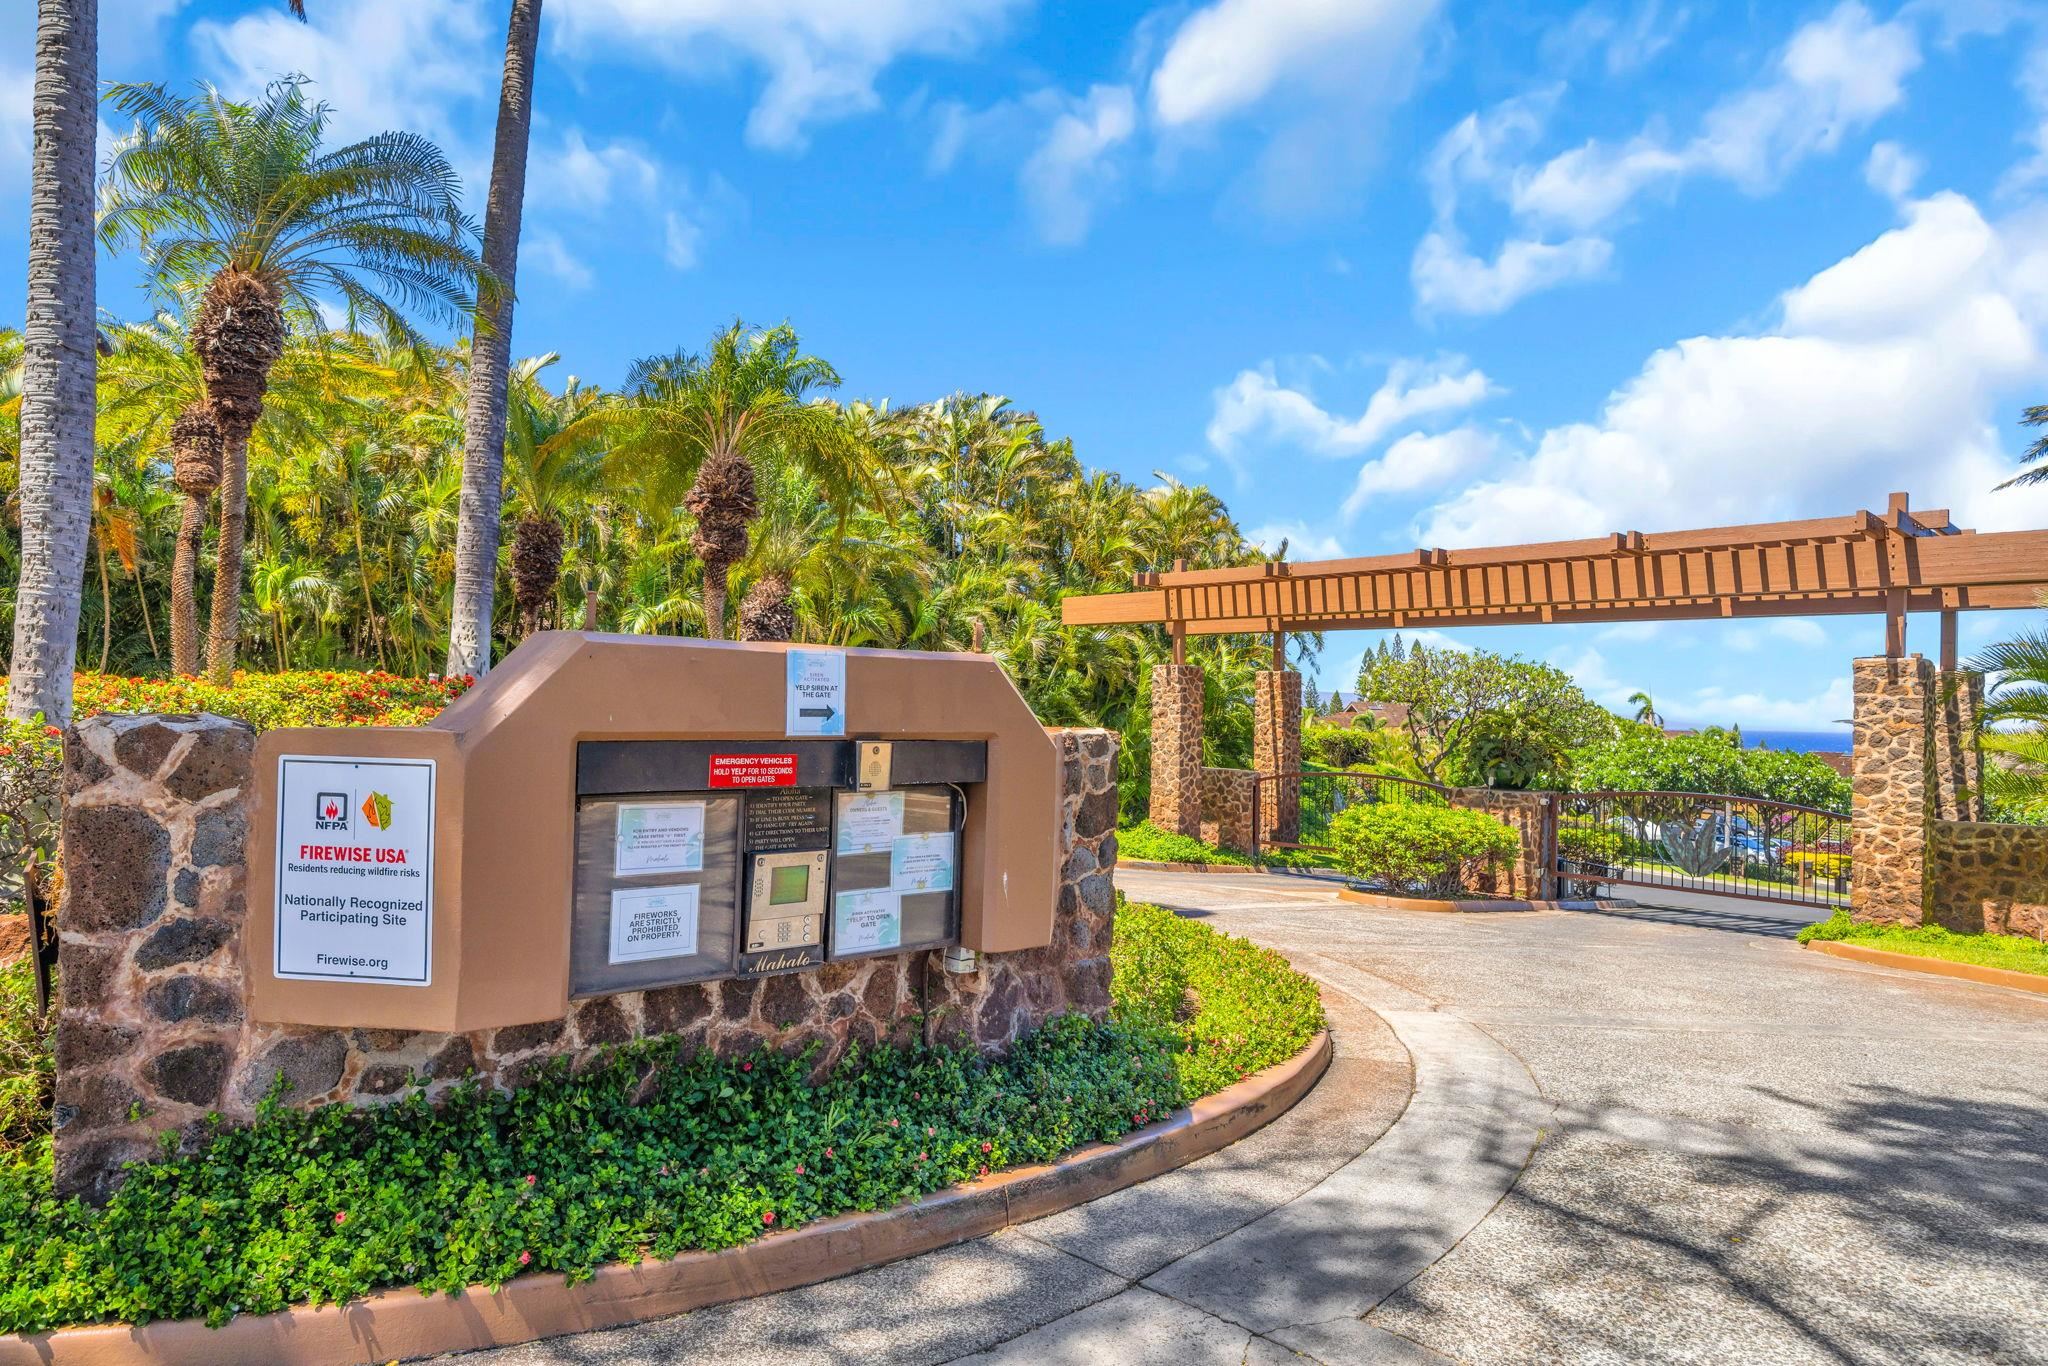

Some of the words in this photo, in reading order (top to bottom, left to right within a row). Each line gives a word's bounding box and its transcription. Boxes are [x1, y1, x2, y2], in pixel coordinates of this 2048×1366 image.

[316, 821, 348, 831] NFPA
[300, 845, 371, 862] FIREWISE
[375, 849, 406, 864] USA
[288, 863, 328, 873] Residents
[330, 864, 365, 877] reducing
[368, 866, 398, 876] wildfire
[400, 869, 420, 878] risks
[285, 894, 346, 910] Nationally
[350, 897, 423, 912] Recognized
[300, 910, 378, 927] Participating
[382, 914, 406, 926] Site
[634, 910, 677, 920] FIREWORKS
[646, 917, 681, 926] STRICTLY
[632, 924, 678, 934] PROHIBITED
[641, 931, 682, 940] PROPERTY.
[317, 954, 388, 970] Firewise.org
[749, 951, 810, 973] Mahalo
